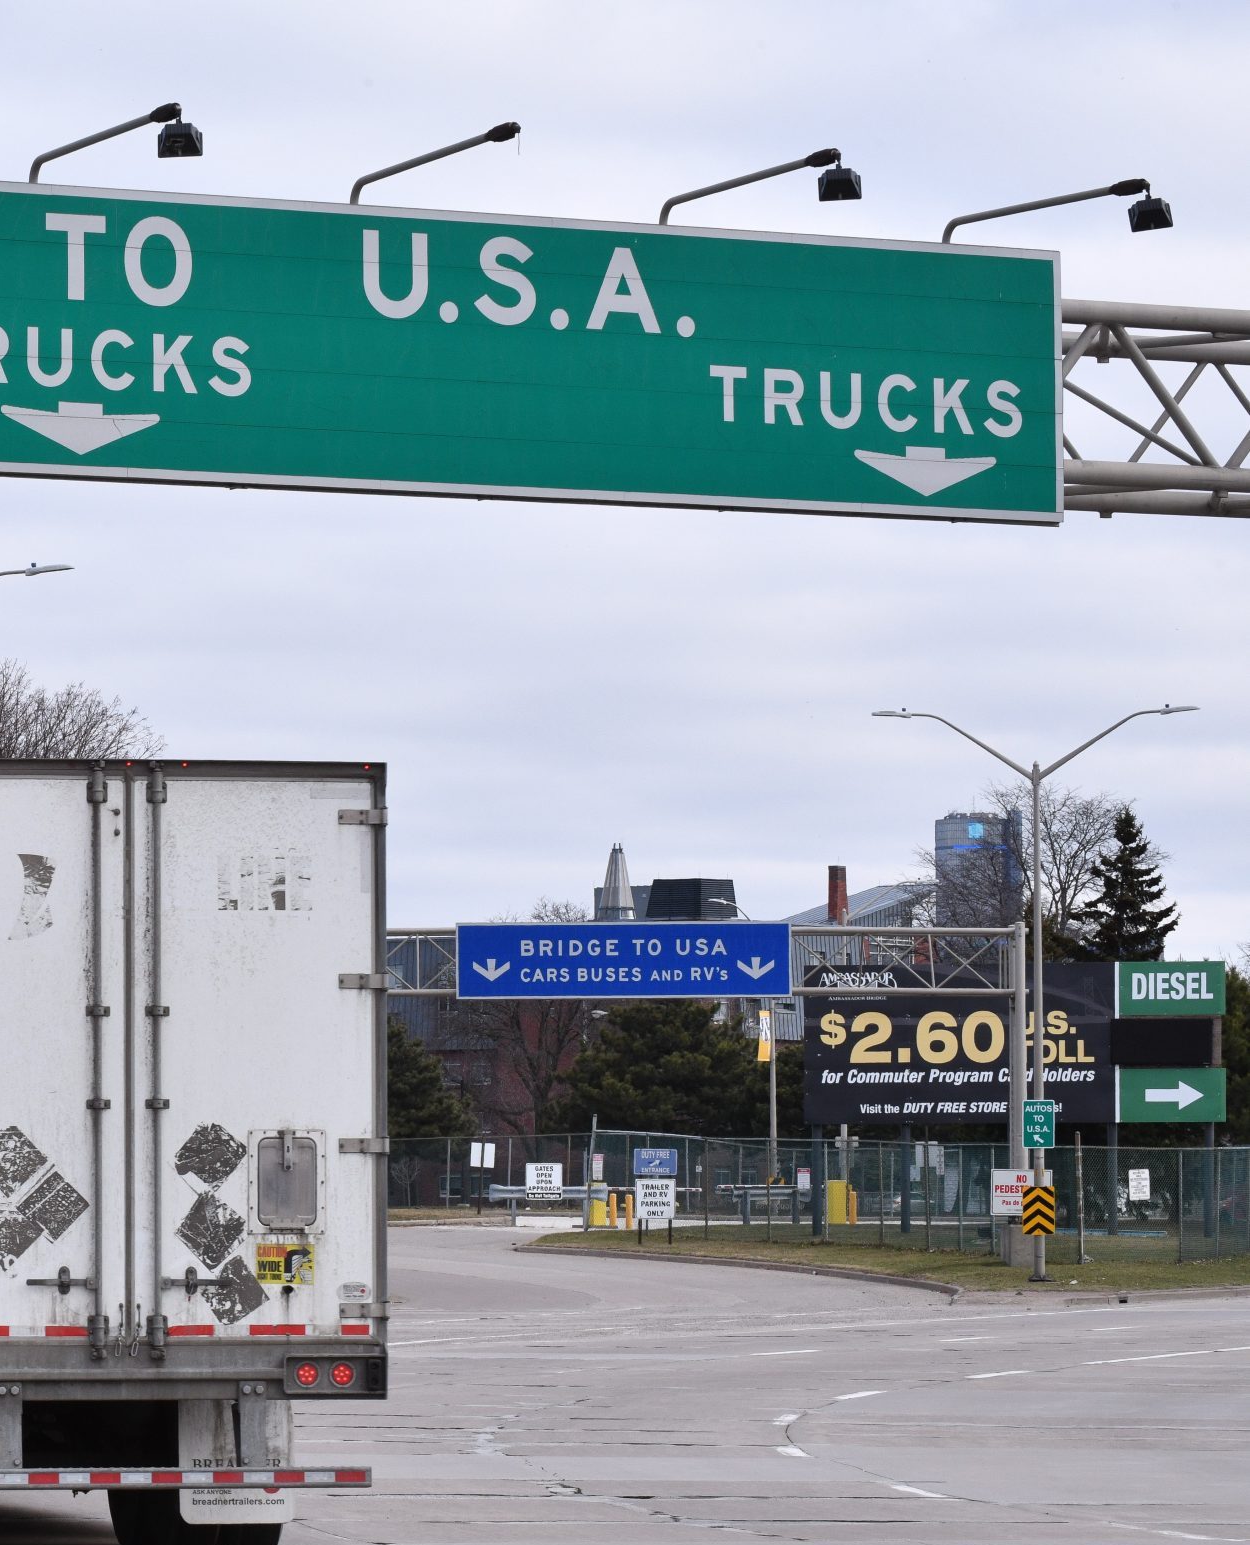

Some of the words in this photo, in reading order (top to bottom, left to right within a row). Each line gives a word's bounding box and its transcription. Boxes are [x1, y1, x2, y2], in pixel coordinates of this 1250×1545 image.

[46, 212, 192, 307] TO
[363, 230, 695, 337] U.S.A.
[710, 364, 1023, 438] TRUCKS
[520, 939, 619, 957] BRIDGE
[632, 939, 662, 956] TO
[676, 938, 728, 955] USA
[520, 968, 570, 982] CARS
[577, 967, 642, 982] BUSES
[651, 969, 683, 981] AND
[690, 967, 729, 981] RV's
[1132, 972, 1214, 1000] DIESEL
[820, 1009, 1005, 1064] $2.60
[821, 1069, 842, 1084] for
[847, 1069, 925, 1084] Commuter
[928, 1068, 993, 1086] Program
[860, 1103, 883, 1114] Visit
[885, 1103, 900, 1114] the
[903, 1102, 934, 1114] DUTY
[936, 1102, 966, 1114] FREE
[969, 1101, 1008, 1113] STORE
[1025, 1103, 1053, 1113] AUTOS
[1033, 1115, 1045, 1123] TO
[1027, 1125, 1051, 1133] U.S.A.
[641, 1151, 655, 1159] DUTY
[656, 1151, 670, 1159] FREE
[1016, 1174, 1027, 1183] NO
[994, 1185, 1023, 1193] PEDEST
[258, 1246, 287, 1258] CAUTION
[258, 1260, 282, 1272] WIDE
[192, 1497, 285, 1506] breadnertrailers.com
